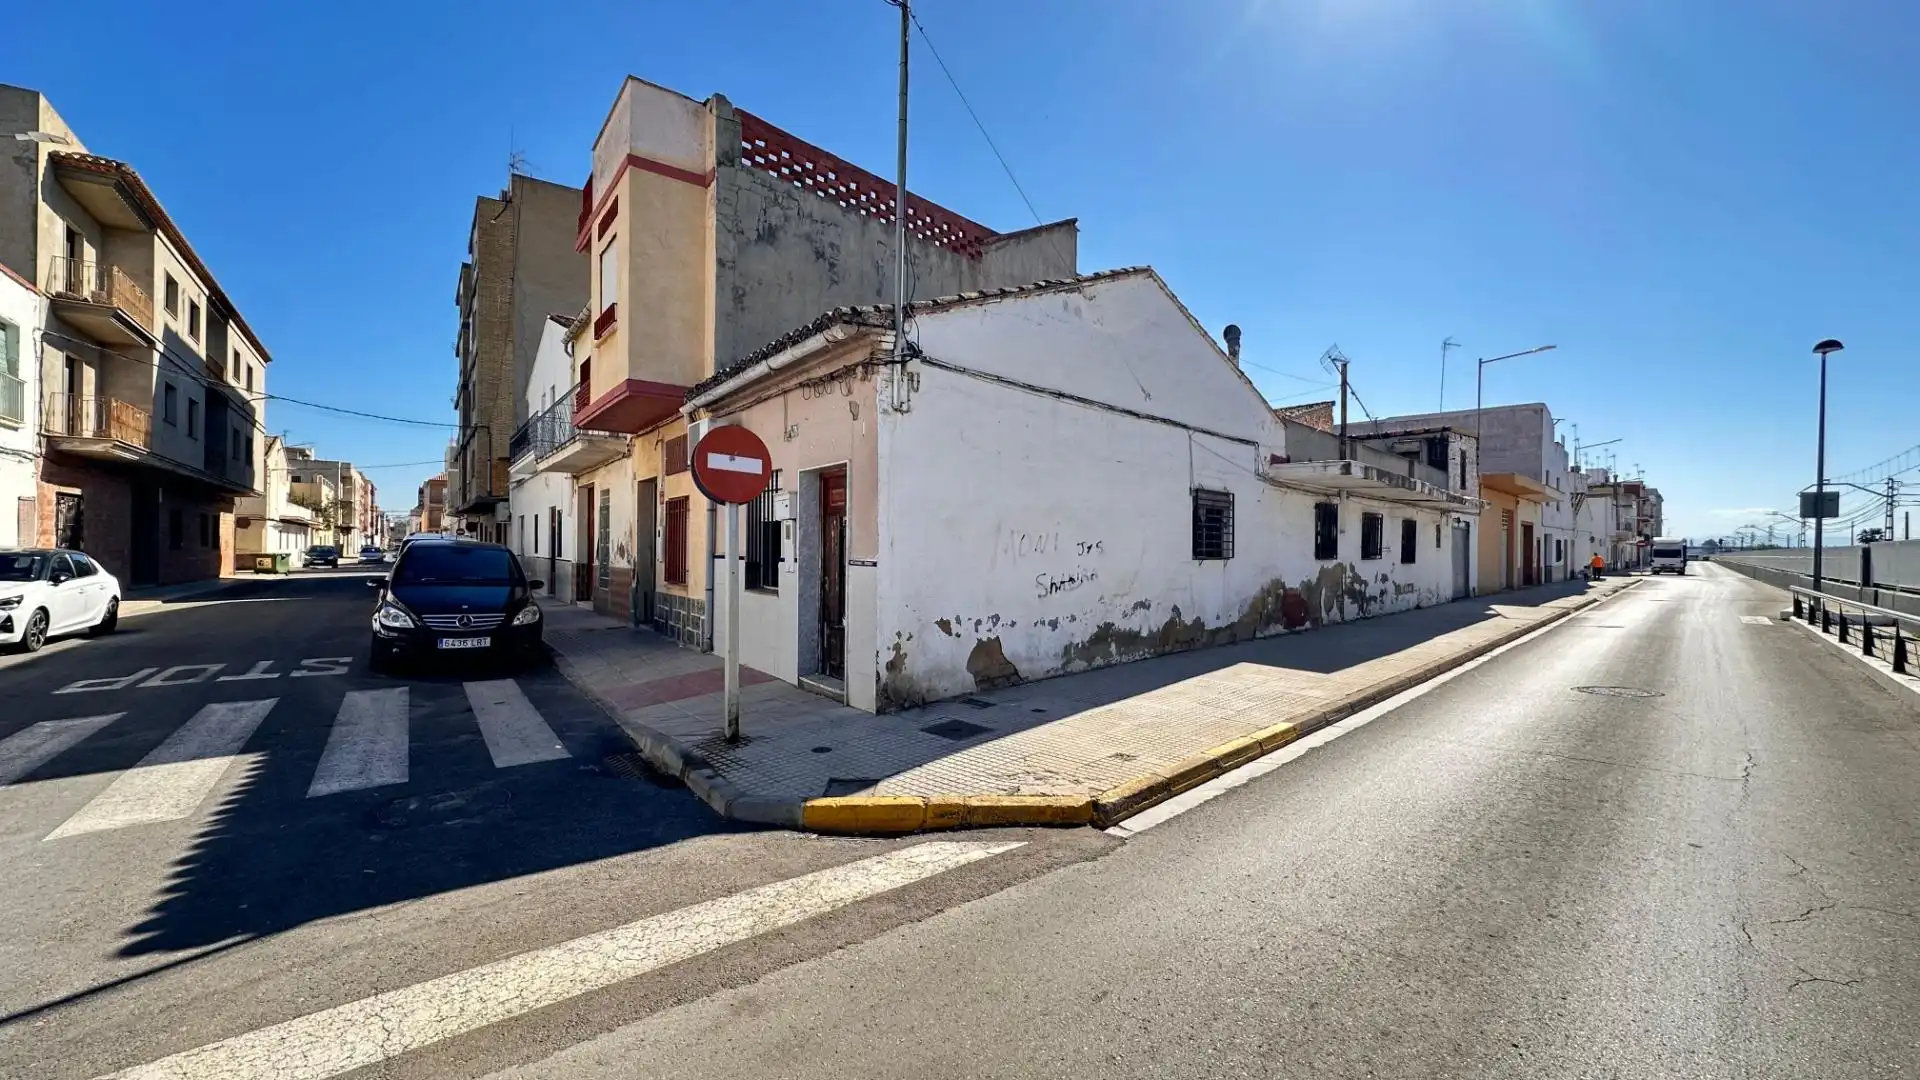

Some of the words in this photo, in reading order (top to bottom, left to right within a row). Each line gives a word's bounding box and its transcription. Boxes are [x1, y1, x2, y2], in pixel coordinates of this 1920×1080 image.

[445, 639, 468, 647] 6436
[471, 638, 488, 647] LRT
[51, 657, 353, 694] STOP
